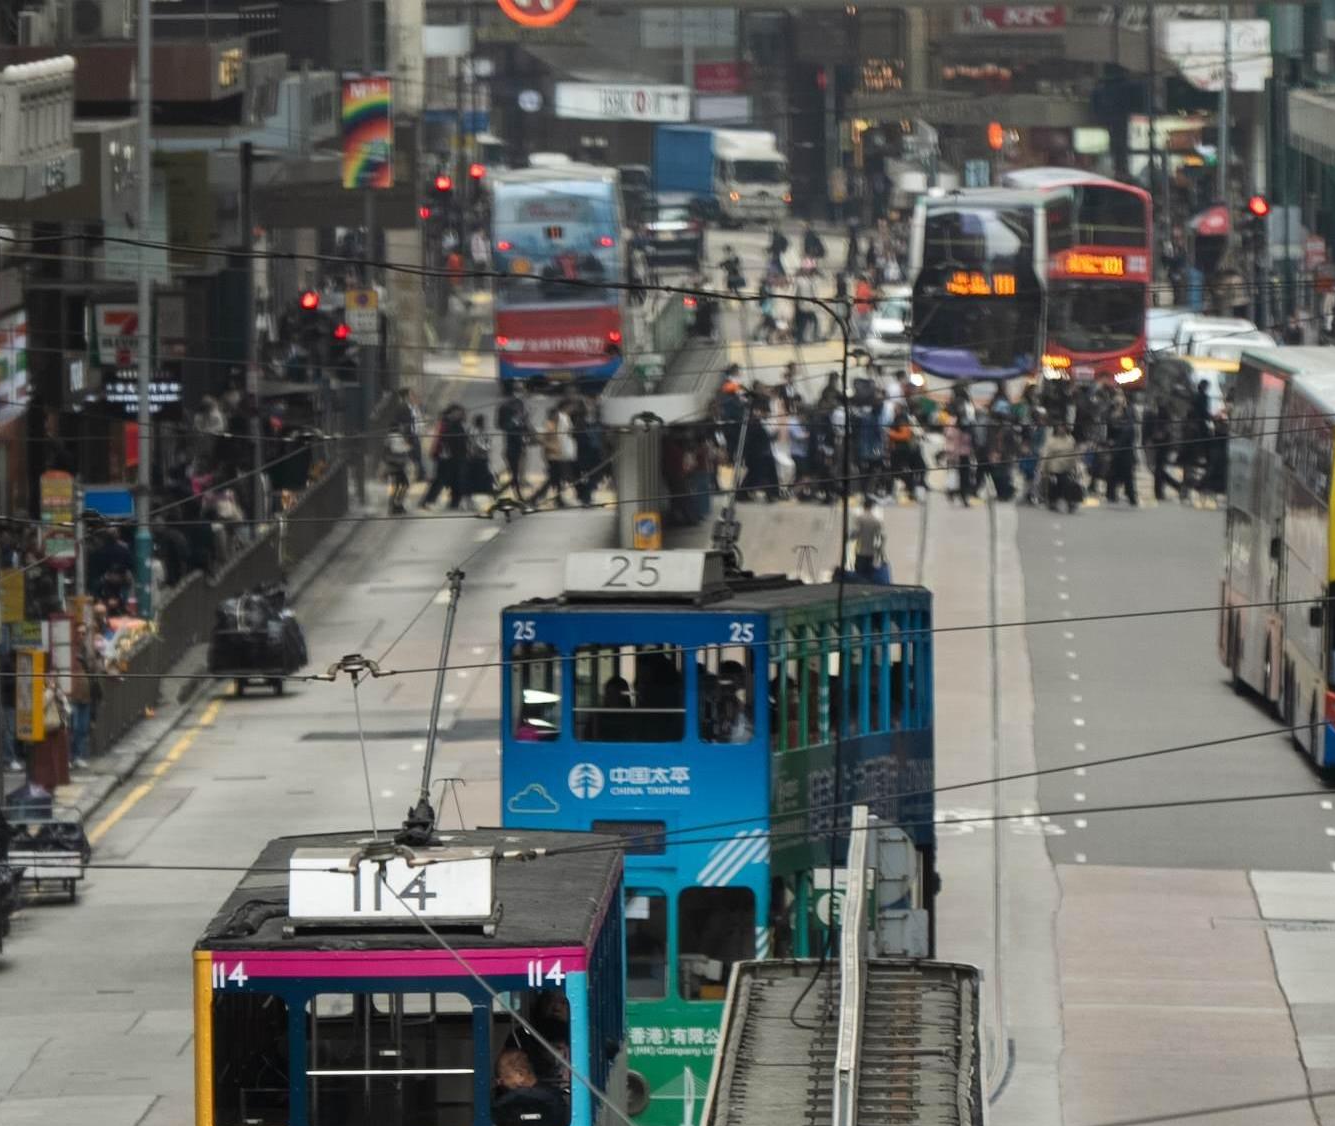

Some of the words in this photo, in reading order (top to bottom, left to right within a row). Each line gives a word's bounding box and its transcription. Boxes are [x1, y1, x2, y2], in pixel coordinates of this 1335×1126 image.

[604, 556, 661, 587] 25
[513, 621, 536, 640] 25
[729, 623, 755, 642] 25
[610, 767, 690, 784] 中国太平
[353, 868, 437, 912] 114
[211, 961, 248, 989] 114
[528, 960, 566, 987] 114
